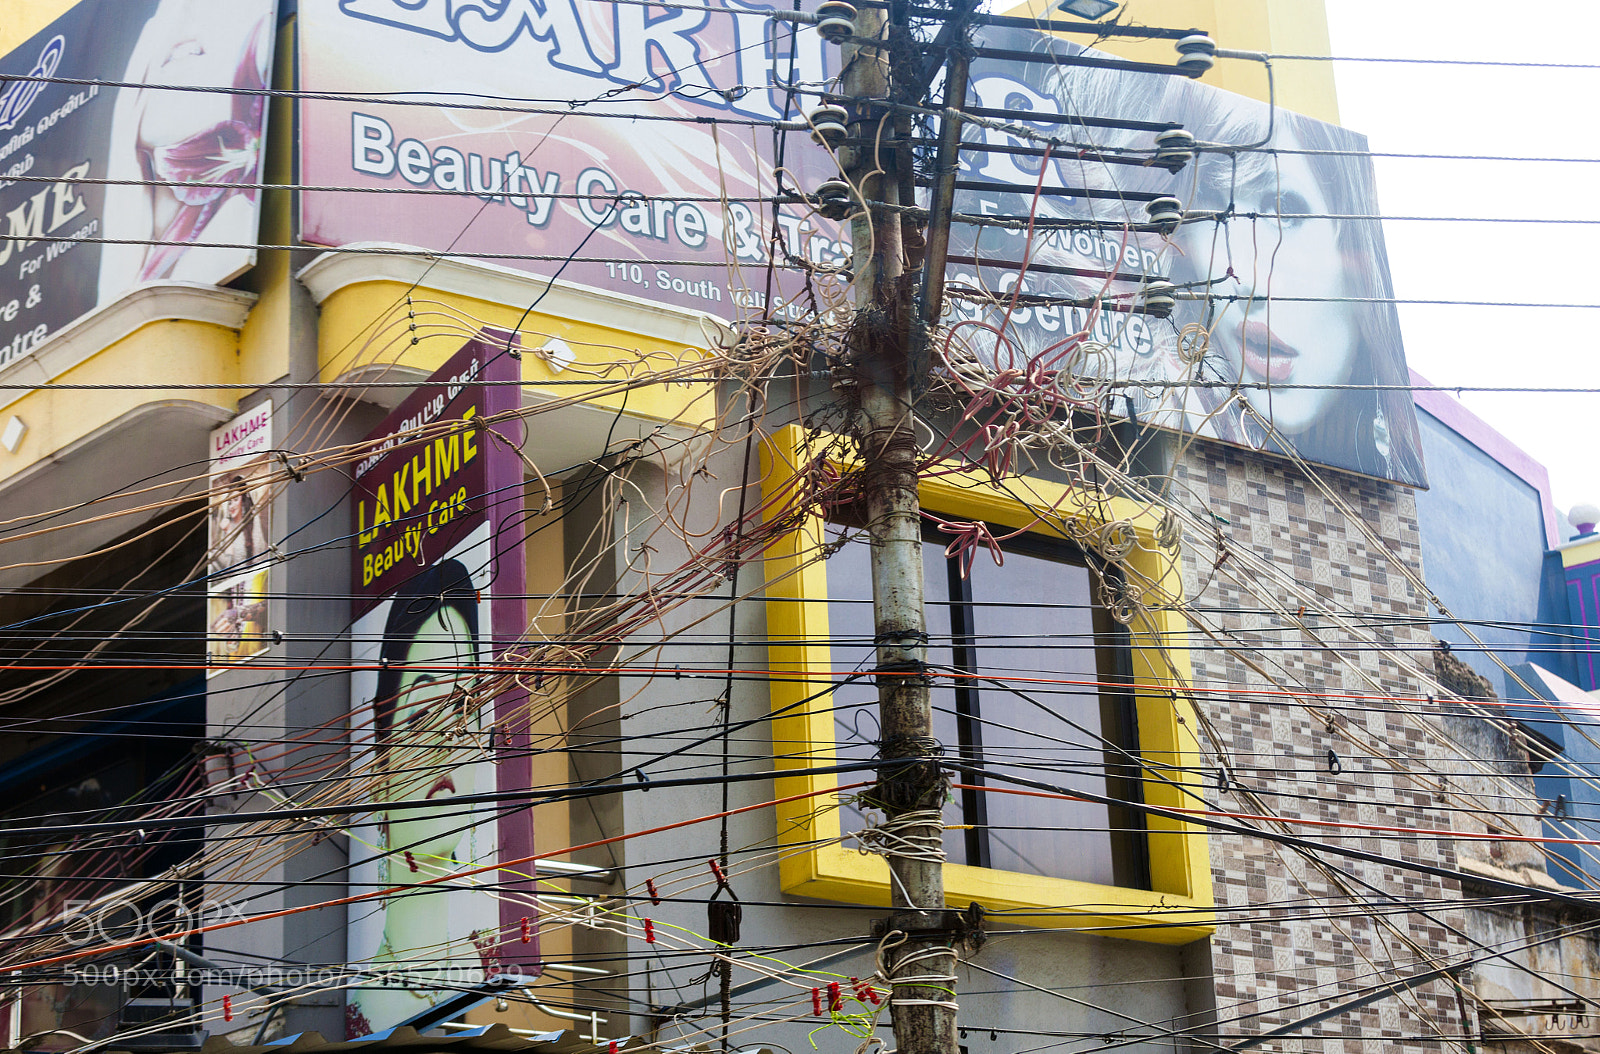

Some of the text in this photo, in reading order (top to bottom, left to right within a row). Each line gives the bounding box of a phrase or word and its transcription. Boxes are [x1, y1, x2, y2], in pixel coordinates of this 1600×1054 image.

[19, 219, 98, 280] For Women
[351, 112, 559, 228] Beauty
[576, 167, 706, 247] Care
[722, 202, 764, 262] &
[998, 272, 1152, 355] Centre
[25, 284, 42, 309] &
[605, 261, 649, 288] 110,
[655, 269, 722, 302] South
[215, 411, 267, 452] LAKHME
[246, 435, 264, 450] Care
[358, 404, 478, 550] LAKHME
[362, 486, 467, 587] Beauty Care
